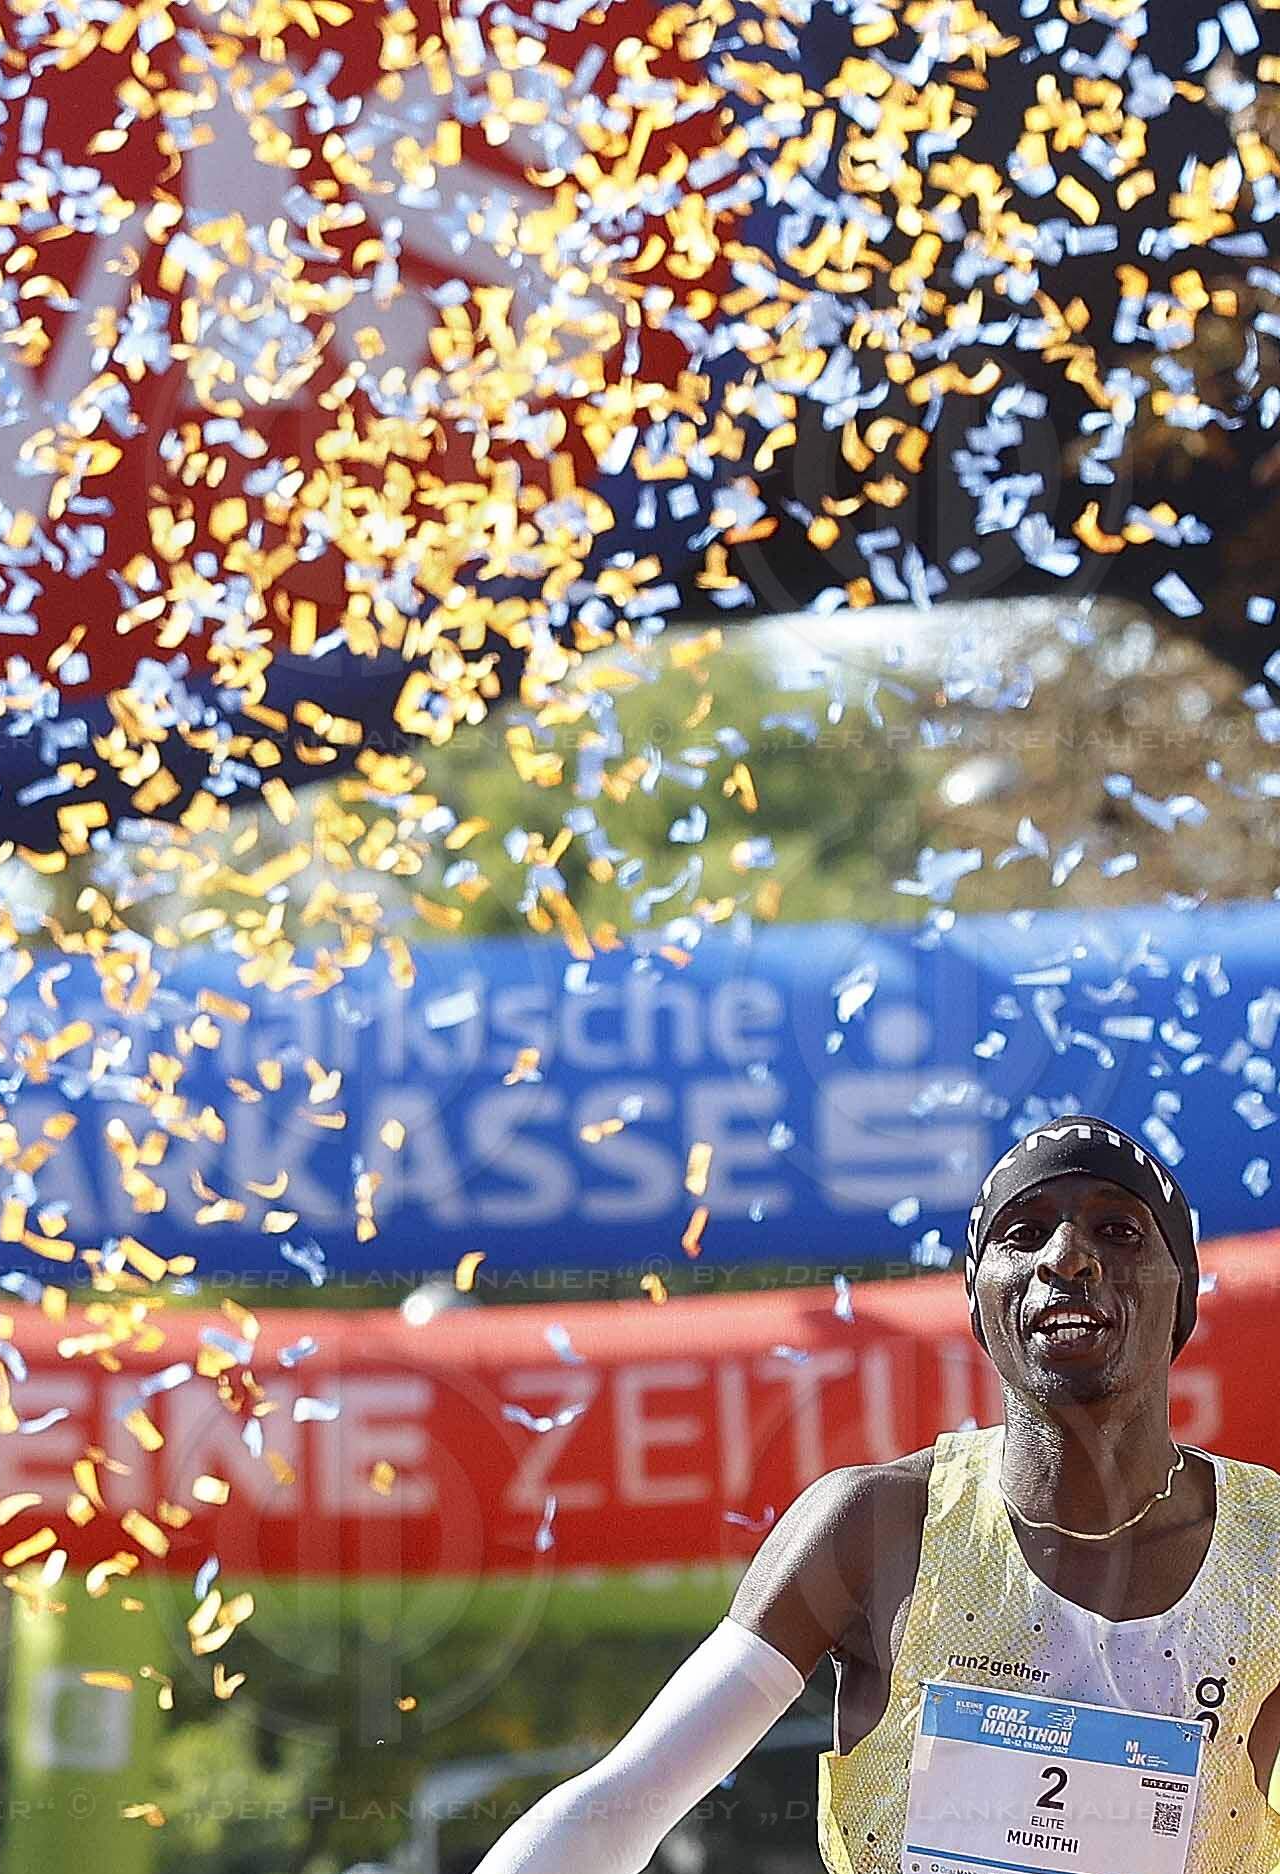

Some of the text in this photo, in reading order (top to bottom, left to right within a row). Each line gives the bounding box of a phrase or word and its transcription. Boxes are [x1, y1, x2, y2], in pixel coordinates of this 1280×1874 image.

[500, 1343, 1223, 1514] ZEITU
[947, 1653, 1050, 1684] run2gether
[986, 1704, 1030, 1724] GRAZ
[980, 1719, 1072, 1746] MARATHON
[1125, 1740, 1140, 1753] M
[1127, 1753, 1146, 1766] JK
[1036, 1766, 1068, 1811] 2
[1031, 1815, 1065, 1830] ELITE
[1006, 1829, 1079, 1853] MURITHI
